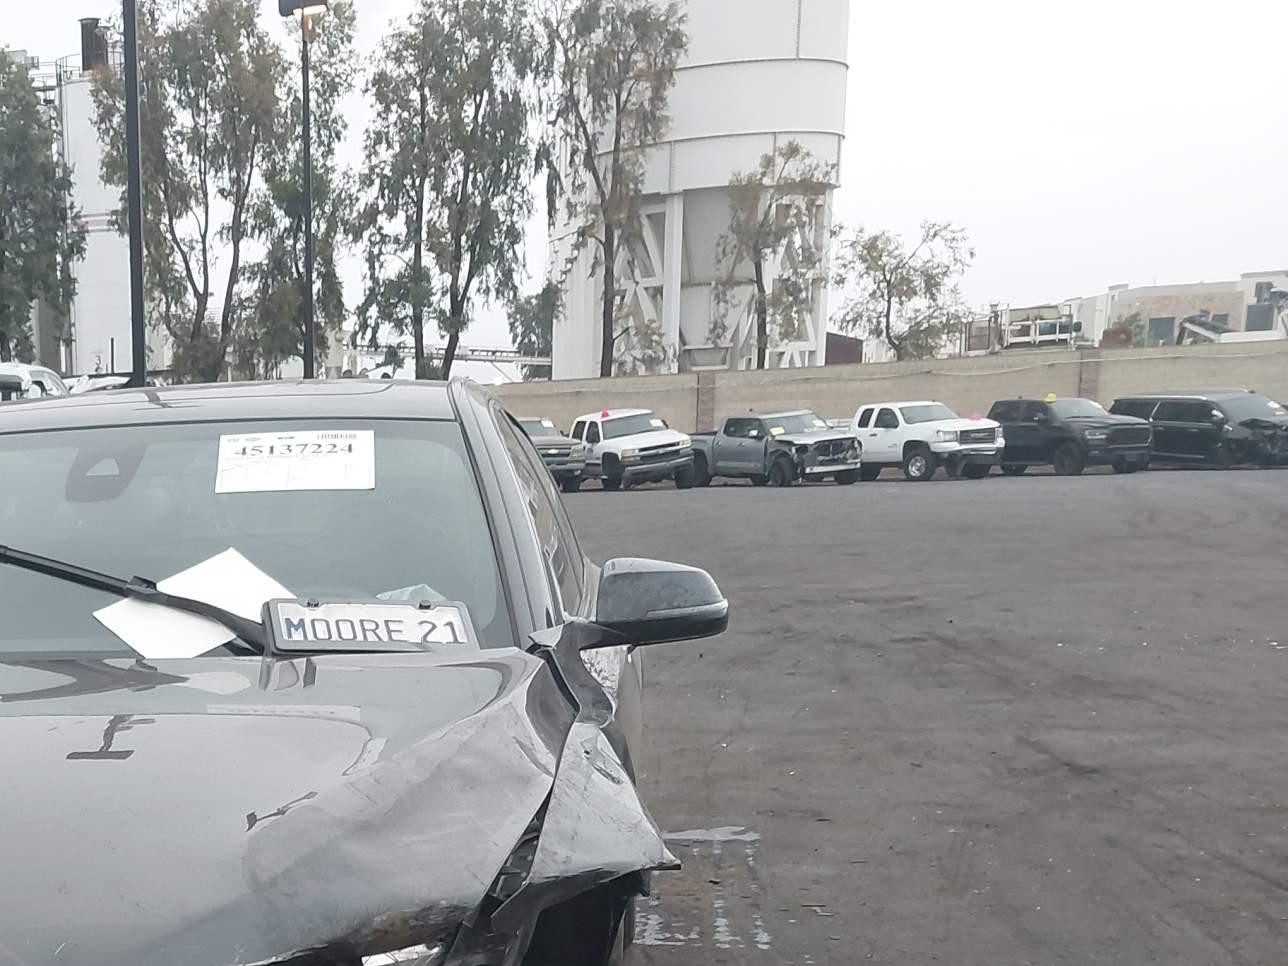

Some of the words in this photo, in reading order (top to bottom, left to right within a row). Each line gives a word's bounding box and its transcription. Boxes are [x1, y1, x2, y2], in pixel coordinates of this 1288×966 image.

[234, 443, 353, 456] 45137224
[284, 617, 404, 643] MOORE
[418, 620, 461, 645] 21
